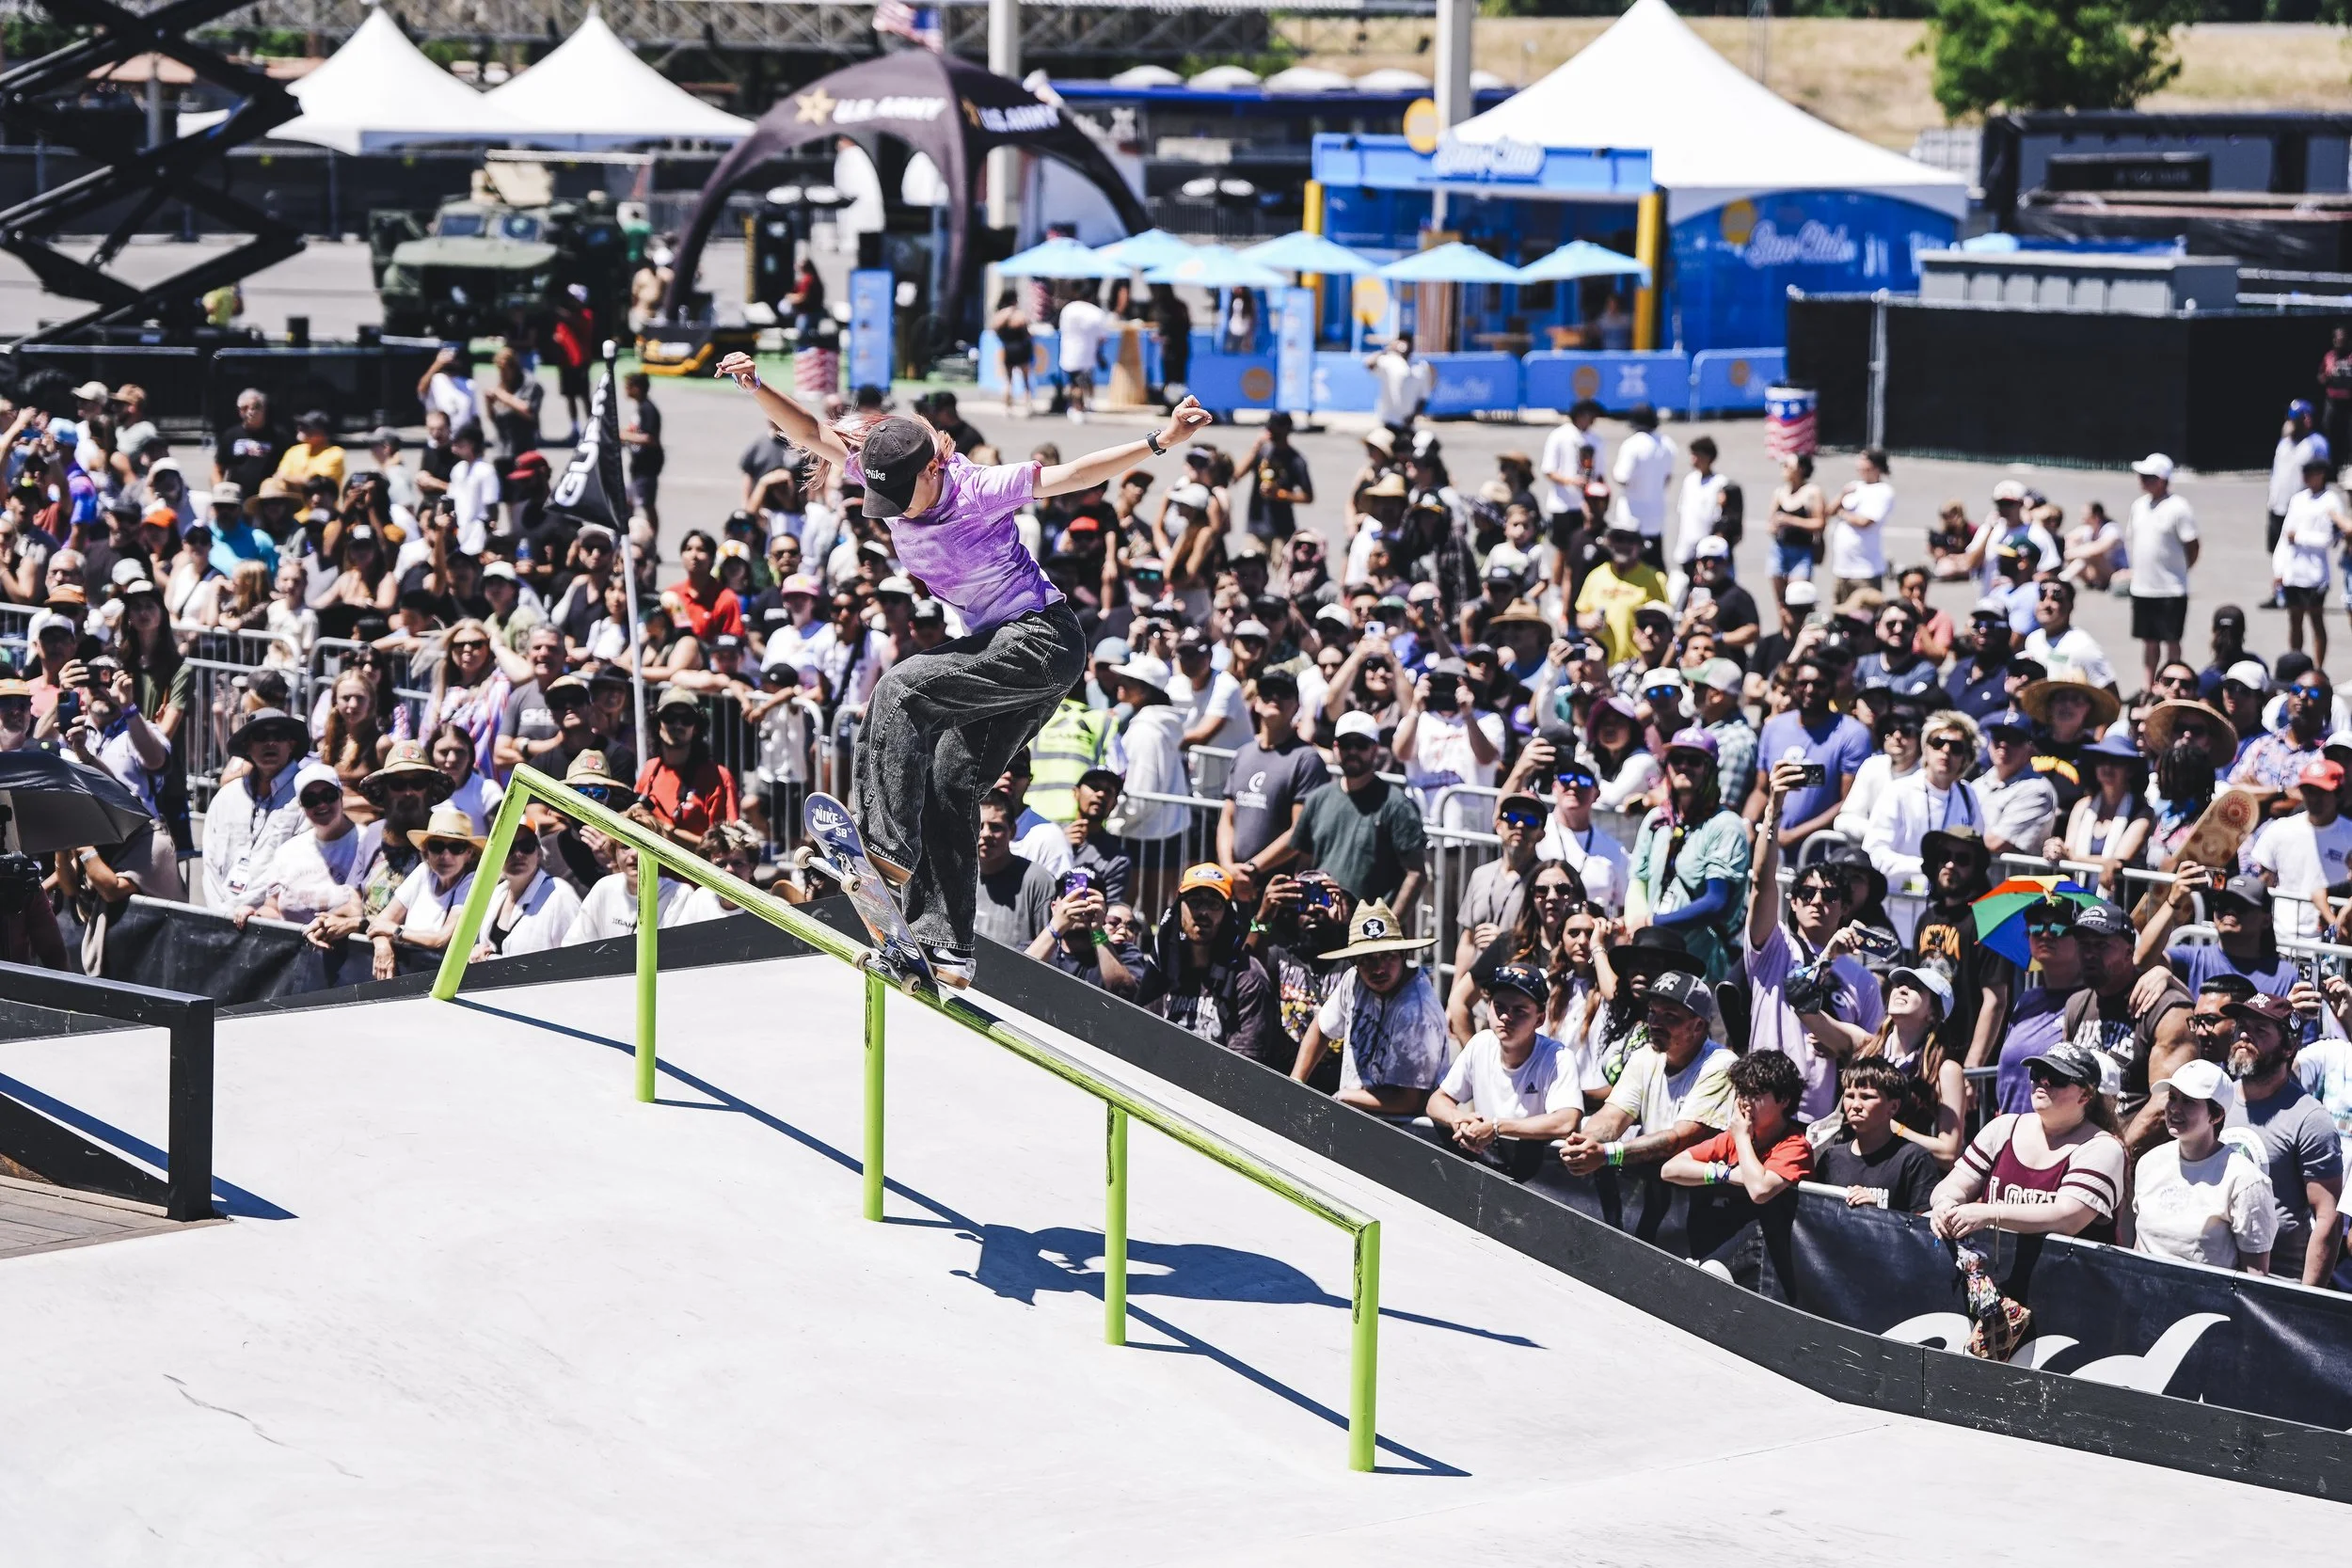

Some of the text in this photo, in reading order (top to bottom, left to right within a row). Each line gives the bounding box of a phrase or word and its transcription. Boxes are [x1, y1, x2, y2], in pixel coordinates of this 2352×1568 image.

[875, 95, 947, 121] ARMY
[865, 468, 886, 482] Nike
[815, 808, 838, 824] NIKE
[835, 827, 848, 838] SB
